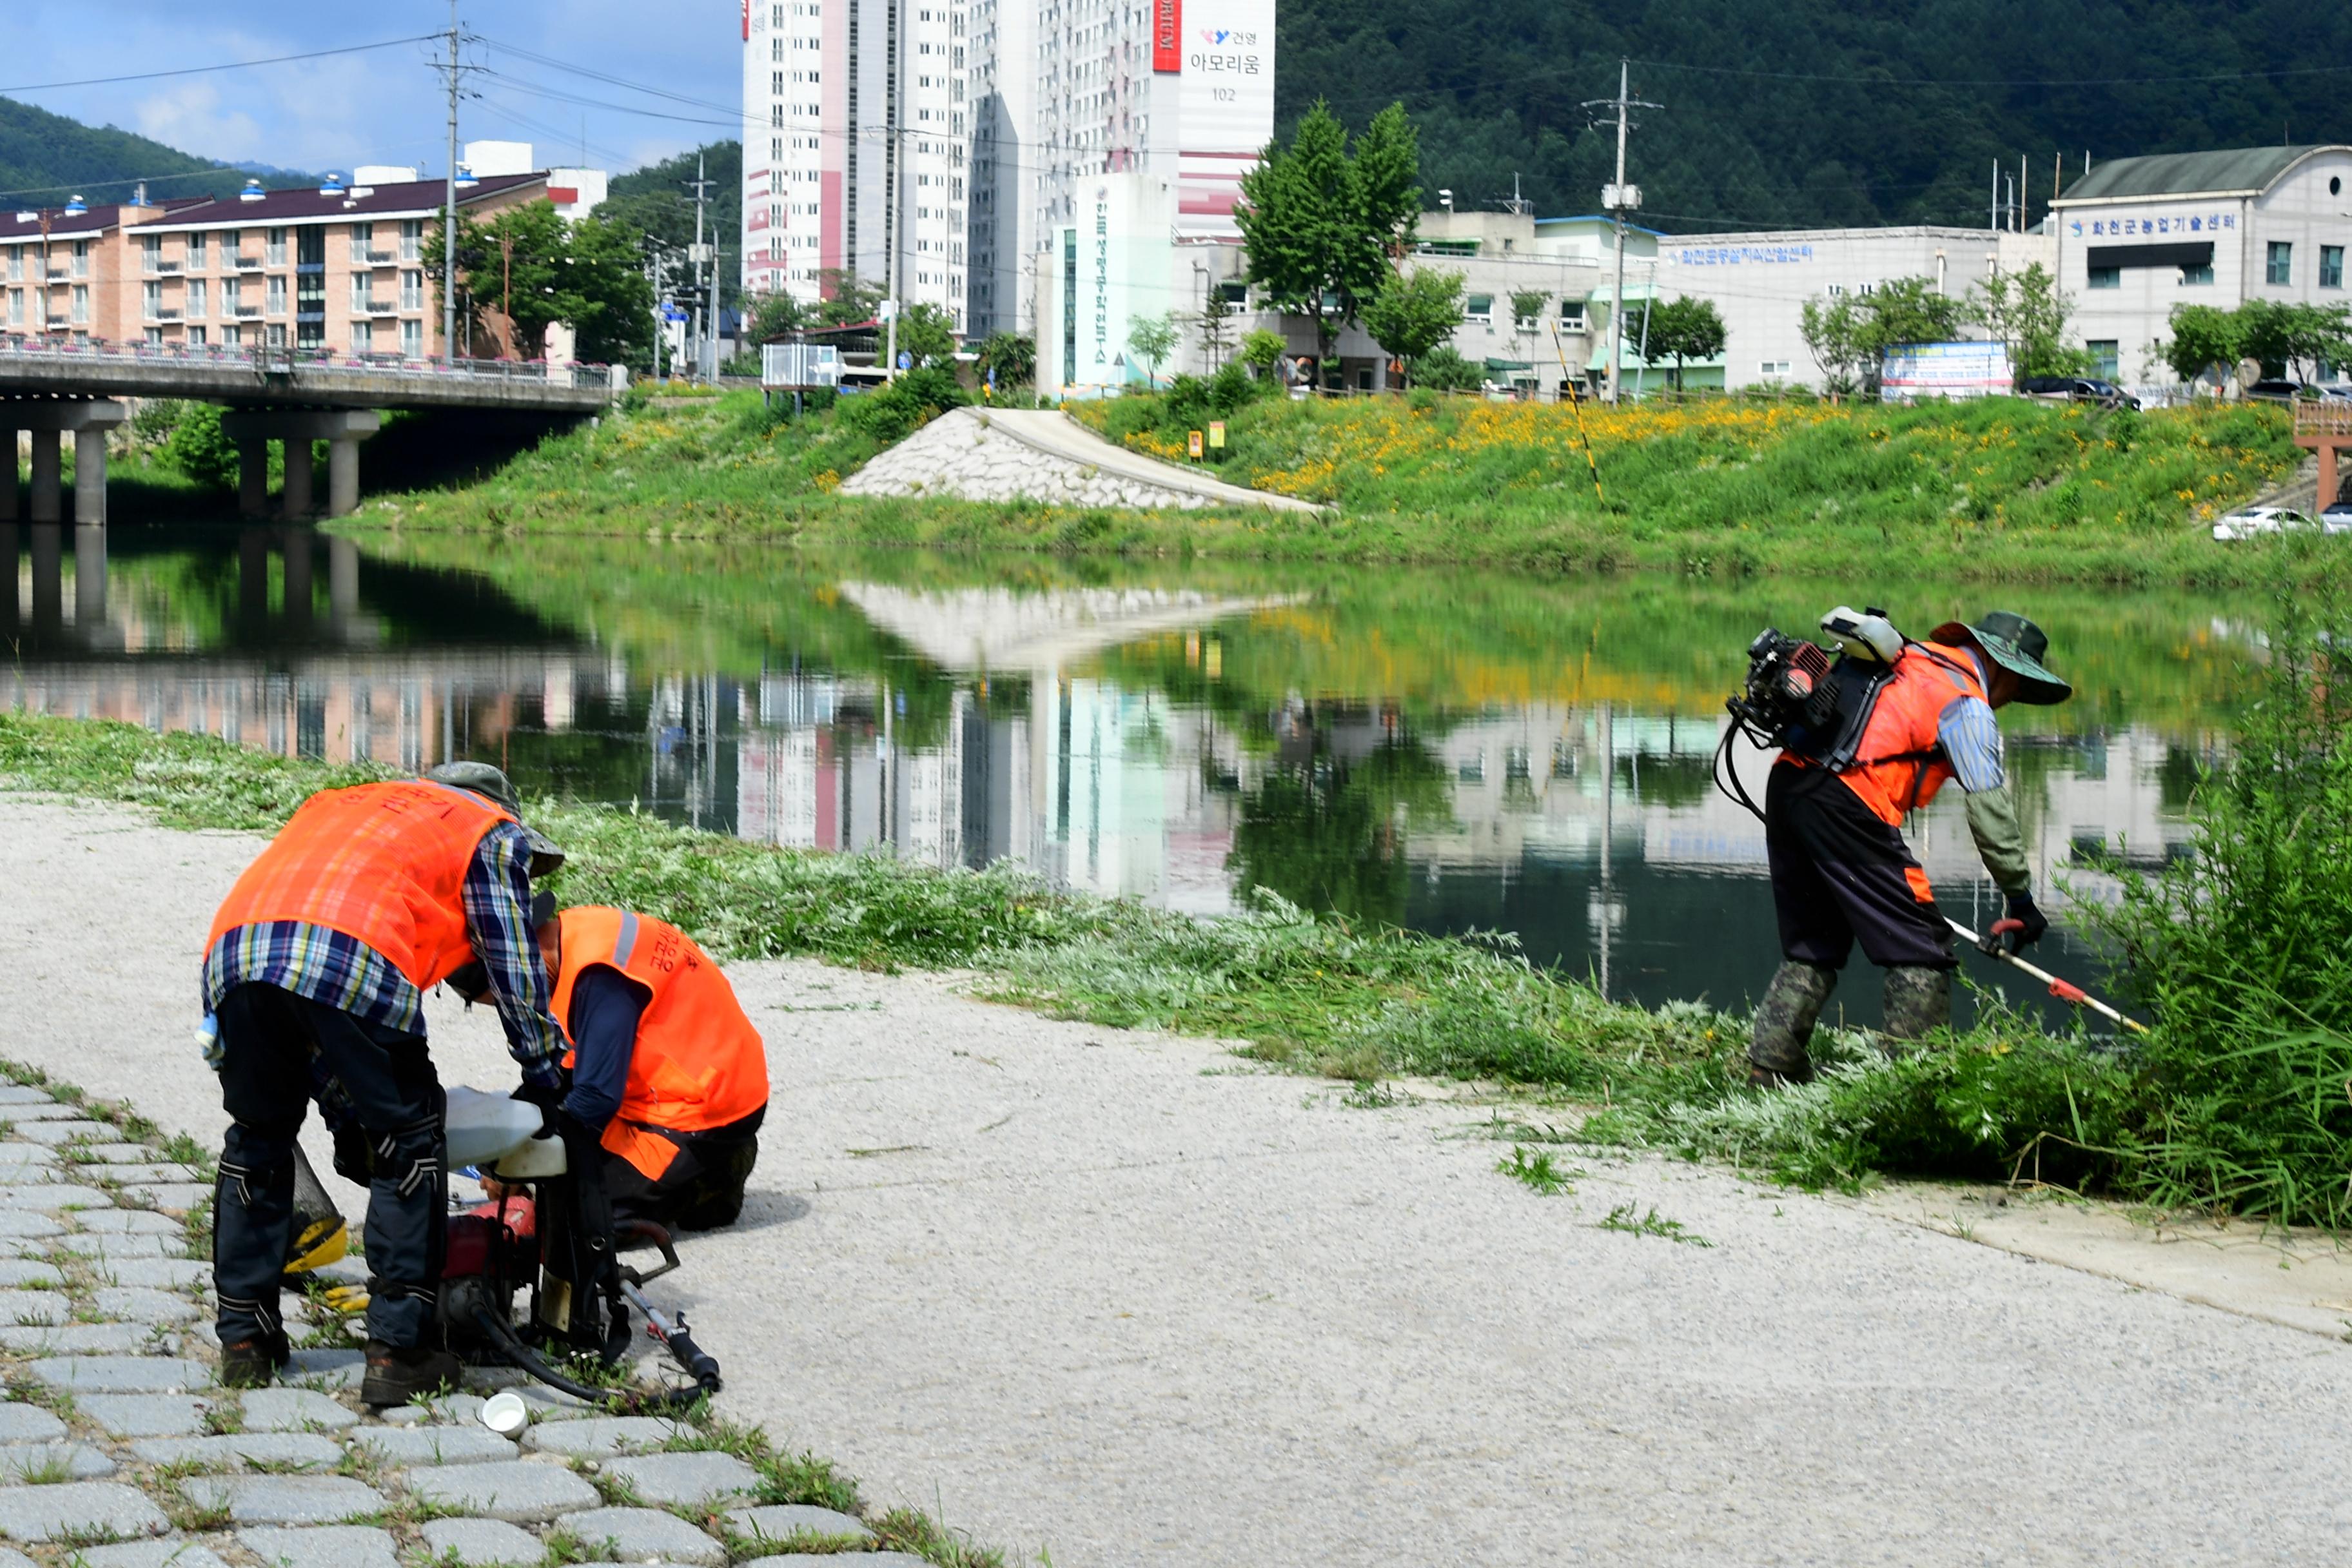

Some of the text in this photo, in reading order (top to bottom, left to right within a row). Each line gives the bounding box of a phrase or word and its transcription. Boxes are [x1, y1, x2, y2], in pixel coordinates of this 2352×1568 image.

[1233, 32, 1256, 45] 건영
[1191, 53, 1260, 74] 아모리움
[1213, 88, 1236, 101] 102
[2092, 213, 2235, 236] 화천군농업기술센터
